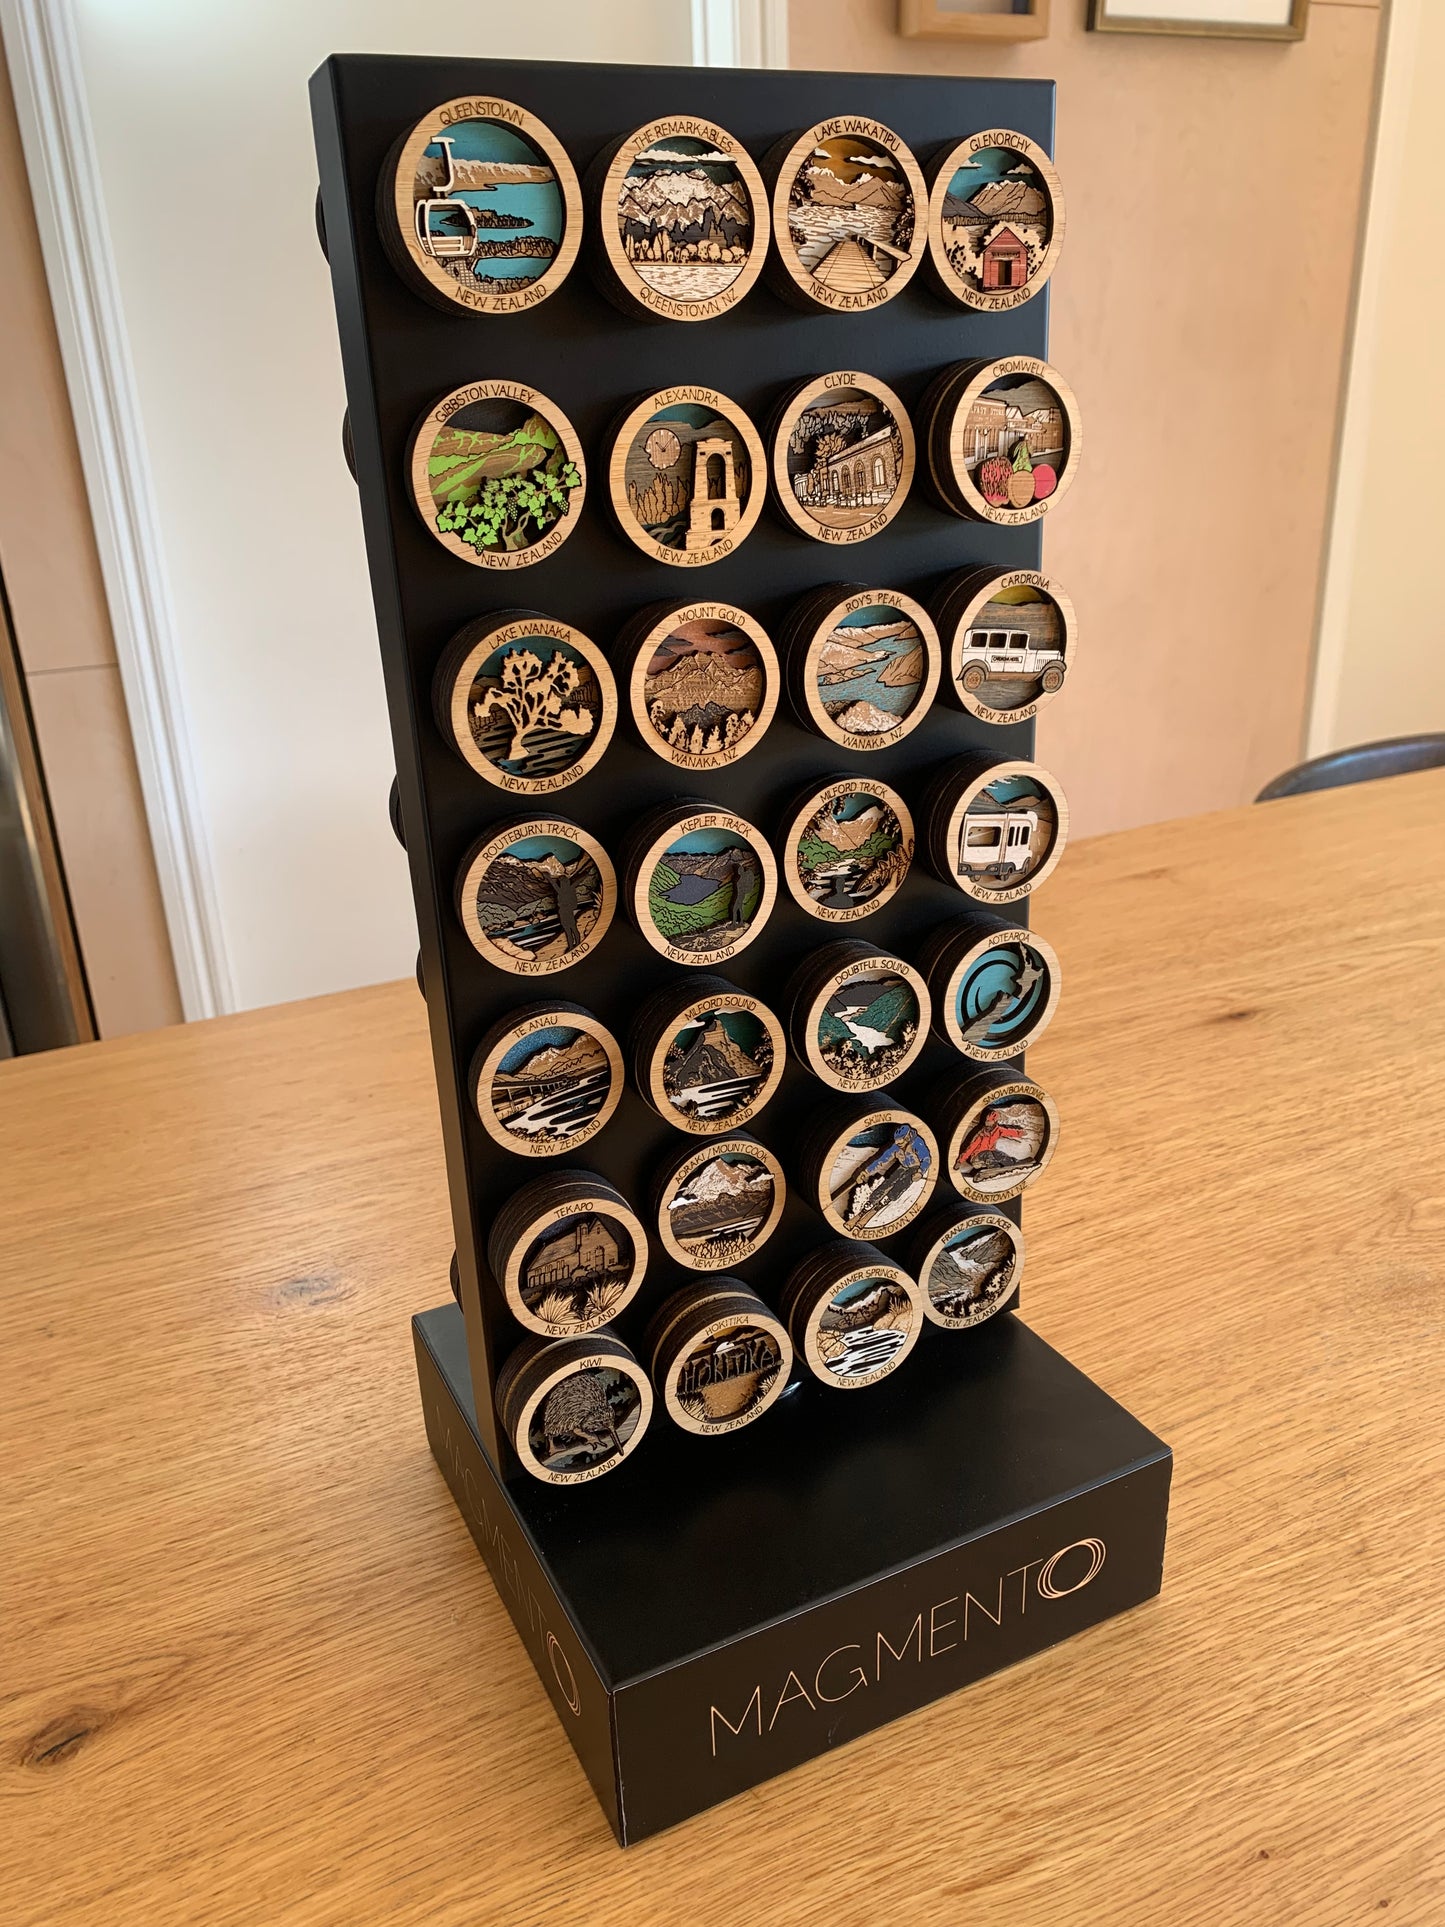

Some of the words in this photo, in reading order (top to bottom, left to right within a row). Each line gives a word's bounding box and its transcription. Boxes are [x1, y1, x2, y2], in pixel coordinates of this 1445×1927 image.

[440, 102, 524, 125] QUEENSTOWN
[632, 131, 656, 151] THE
[654, 124, 734, 153] REMARKABLES
[814, 120, 842, 142] LAKE
[844, 120, 900, 151] WAKATIPU
[970, 132, 1031, 153] GLENORCHY
[455, 287, 489, 308] NEW
[493, 284, 547, 311] ZEALAND
[721, 288, 738, 307] NZ
[809, 282, 836, 304] NEW
[839, 287, 888, 308] ZEALAND
[962, 288, 986, 306] NEW
[989, 288, 1031, 309] ZEALAND
[825, 373, 856, 388] CLYDE
[993, 360, 1045, 378] CROMWELL
[435, 385, 489, 423] GIBBSTON
[491, 385, 535, 404] VALLEY
[654, 389, 719, 410] ALEXANDRA
[982, 504, 1005, 522] NEW
[1008, 502, 1048, 523] ZEALAND
[818, 526, 843, 541] NEW
[847, 513, 888, 541] ZEALAND
[480, 553, 510, 568] NEW
[516, 532, 562, 566] ZEALAND
[656, 546, 683, 563] NEW
[687, 539, 733, 564] ZEALAND
[1000, 574, 1050, 590] CARDRONA
[845, 594, 872, 612] ROY'S
[878, 593, 902, 606] PEAK
[678, 607, 716, 625] MOUNT
[718, 609, 745, 627] GOLD
[488, 627, 517, 649] LAKE
[518, 623, 572, 641] WANAKA
[974, 704, 994, 720] NEW
[997, 704, 1037, 722] ZEALAND
[890, 727, 904, 739] NZ
[671, 751, 721, 767] WANAKA,
[723, 749, 739, 762] NZ
[500, 775, 529, 792] NEW
[532, 764, 584, 792] ZEALAND
[820, 782, 857, 802] MILFORD
[859, 782, 888, 798] TRACK
[680, 816, 717, 834] KEPLER
[722, 816, 752, 837] TRACK
[482, 824, 543, 862] ROUTEBURN
[547, 824, 579, 840] TRACK
[970, 886, 992, 900] NEW
[993, 883, 1032, 900] ZEALAND
[814, 906, 838, 920] NEW
[840, 900, 880, 920] ZEALAND
[988, 932, 1030, 947] AOTEAROA
[515, 961, 542, 972] NEW
[545, 942, 590, 971] ZEALAND
[664, 946, 689, 963] NEW
[692, 946, 735, 964] ZEALAND
[835, 960, 878, 985] DOUBTFUL
[881, 960, 909, 976] SOUND
[684, 997, 723, 1021] MILFORD
[724, 997, 757, 1011] SOUND
[512, 1028, 526, 1039] TE
[528, 1016, 558, 1032] ANAU
[970, 1047, 990, 1058] NEW
[991, 1040, 1028, 1060] ZEALAND
[837, 1078, 859, 1090] NEW
[861, 1067, 900, 1088] ZEALAND
[982, 1085, 1045, 1105] SNOWBOARDING
[685, 1120, 711, 1132] NEW
[712, 1107, 753, 1131] ZEALAND
[864, 1113, 891, 1127] SKIING
[530, 1145, 555, 1154] NEW
[559, 1120, 601, 1151] ZEALAND
[675, 1153, 705, 1184] AORAKI
[1015, 1182, 1028, 1192] NZ
[554, 1202, 594, 1218] TEKAPO
[909, 1203, 922, 1217] NZ
[941, 1224, 965, 1245] FRANZ
[964, 1216, 985, 1229] JOSEF
[985, 1217, 1012, 1231] GLACIER
[691, 1258, 714, 1268] NEW
[716, 1243, 756, 1267] ZEALAND
[829, 1271, 864, 1296] HANMER
[866, 1268, 898, 1279] SPRINGS
[544, 1325, 569, 1335] NEW
[572, 1308, 617, 1334] ZEALAND
[705, 1316, 749, 1336] HOKITIKA
[943, 1318, 962, 1327] NEW
[963, 1305, 997, 1326] ZEALAND
[579, 1358, 602, 1369] KIWI
[685, 1343, 775, 1393] HOKITIKA
[836, 1377, 857, 1387] NEW
[860, 1361, 896, 1385] ZEALAND
[700, 1424, 722, 1433] NEW
[724, 1405, 763, 1431] ZEALAND
[548, 1472, 572, 1482] NEW
[575, 1459, 616, 1480] ZEALAND
[436, 1405, 581, 1716] MAGMENTO
[710, 1537, 1106, 1757] MAGMENTO
